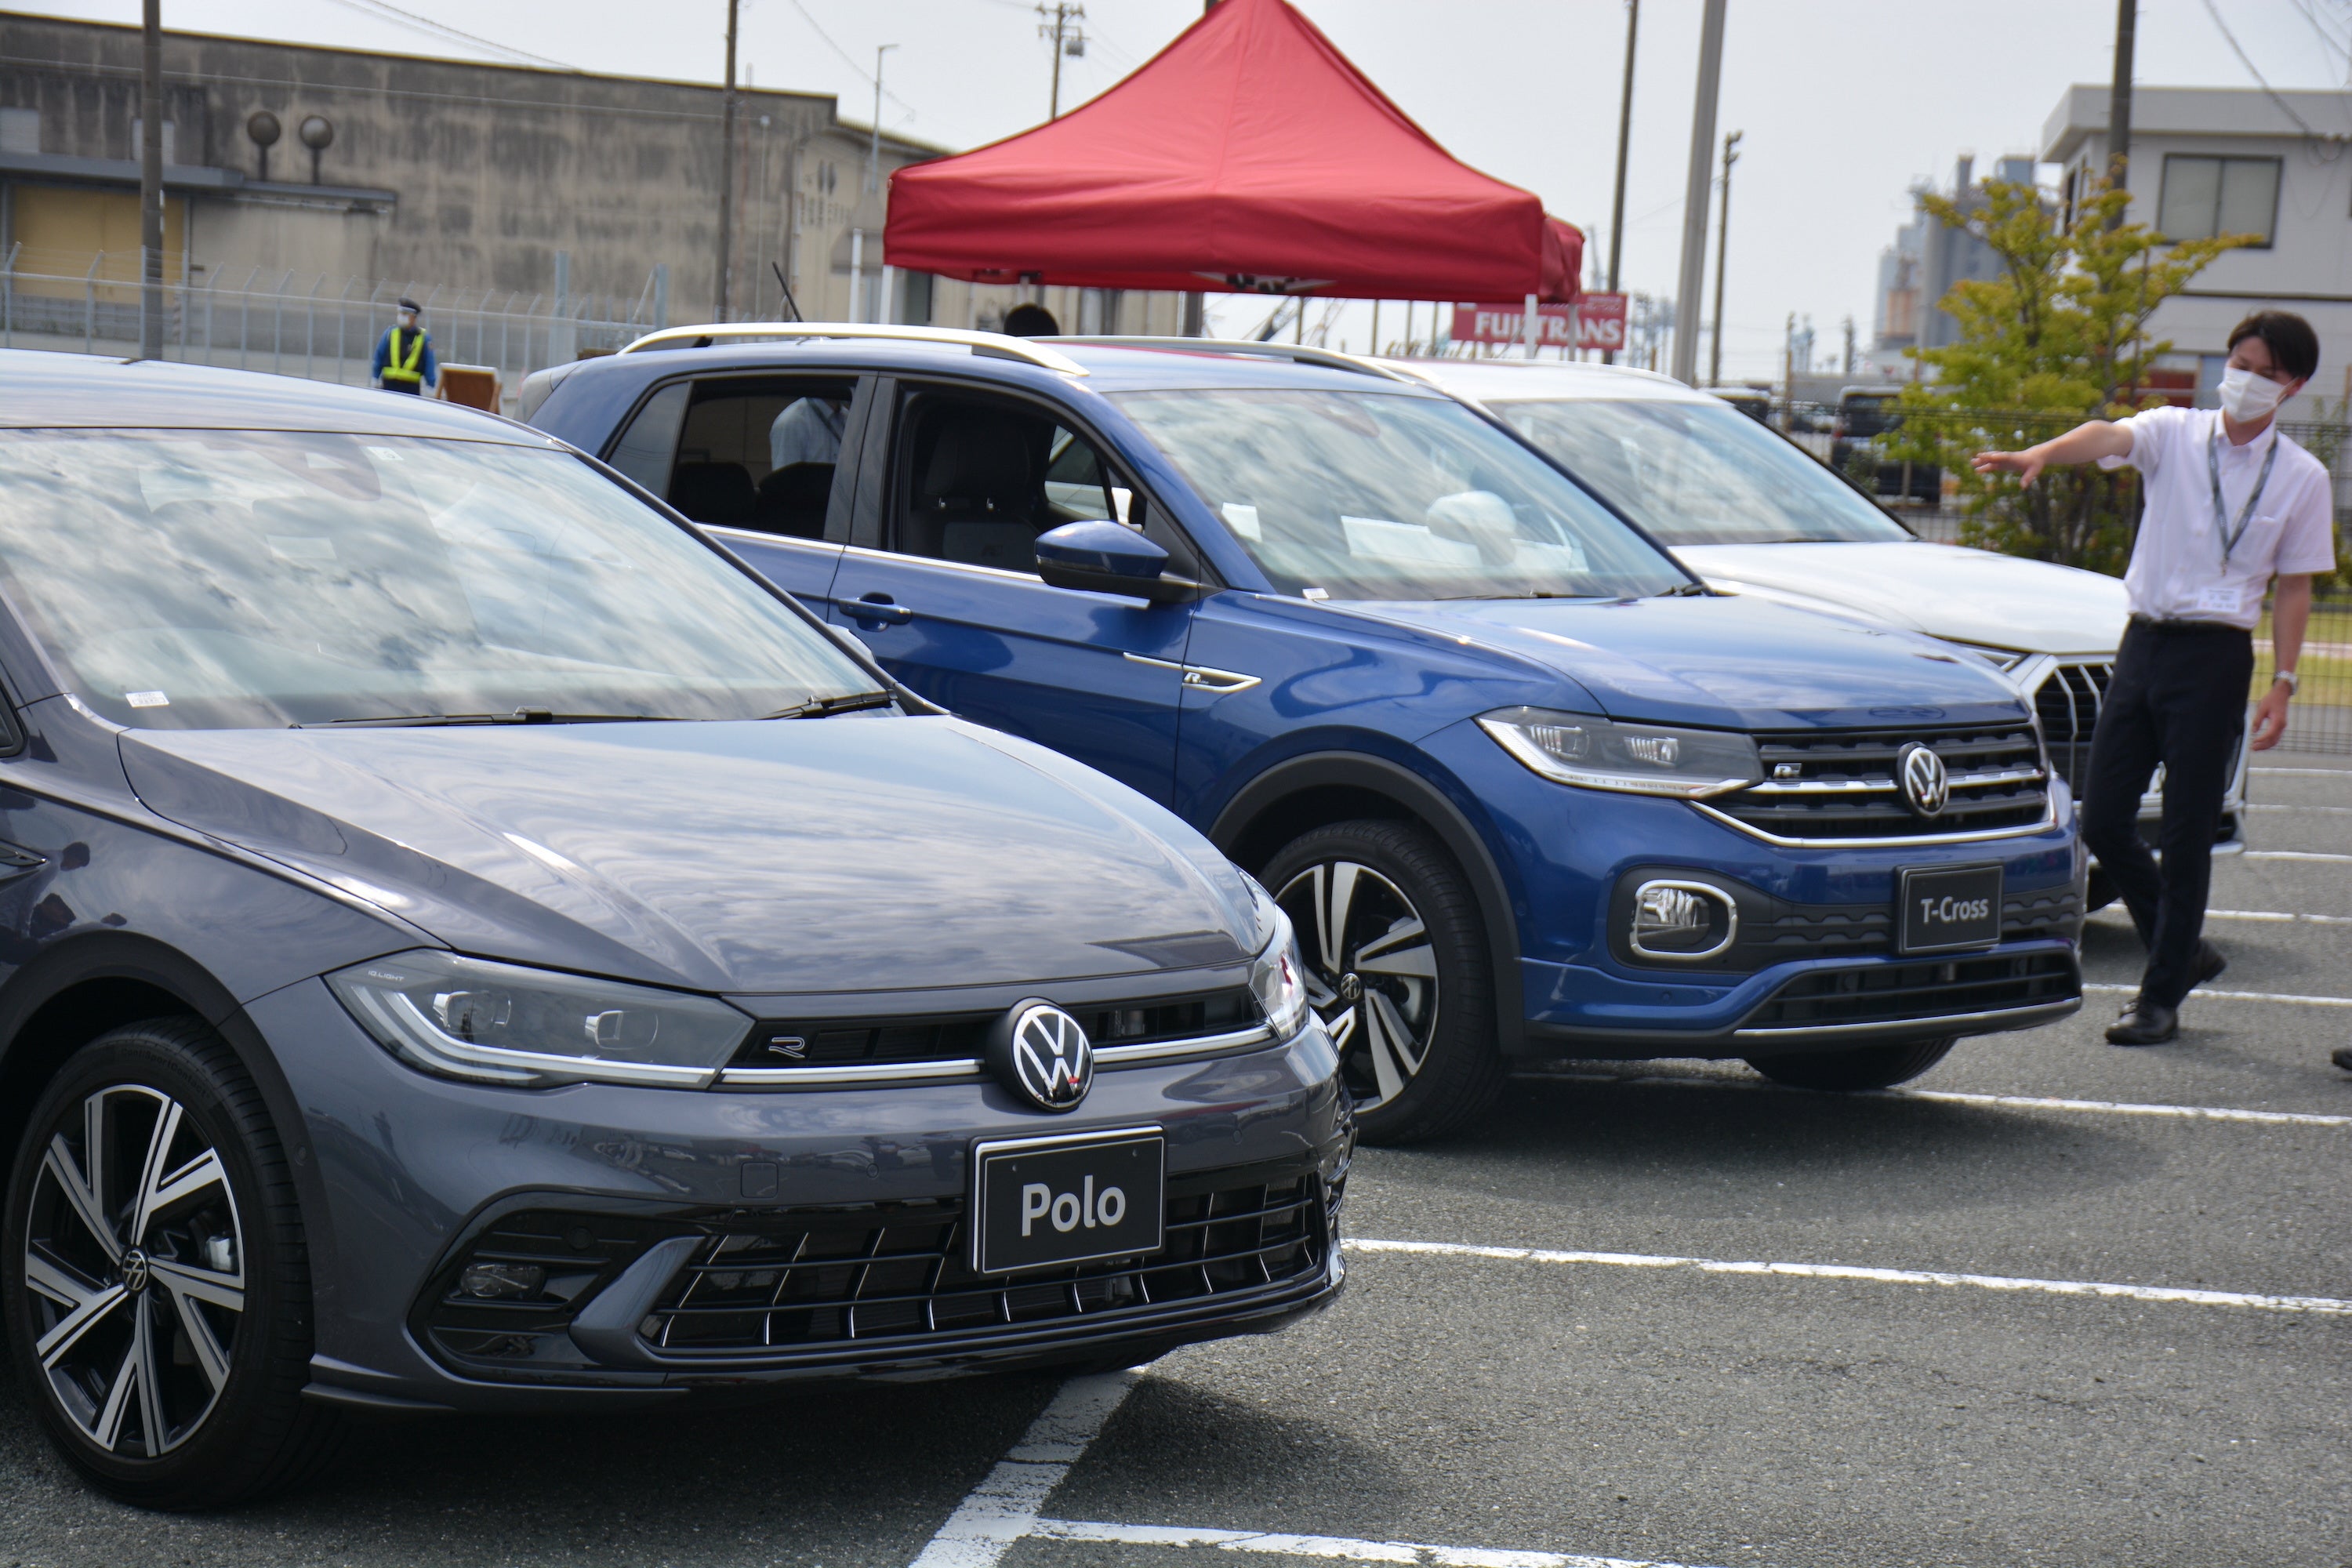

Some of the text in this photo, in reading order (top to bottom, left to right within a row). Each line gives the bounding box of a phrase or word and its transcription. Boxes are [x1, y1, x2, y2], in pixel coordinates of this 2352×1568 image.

[1920, 895, 1989, 924] T-Cross
[1014, 1005, 1092, 1104] VW
[1022, 1174, 1126, 1237] Polo
